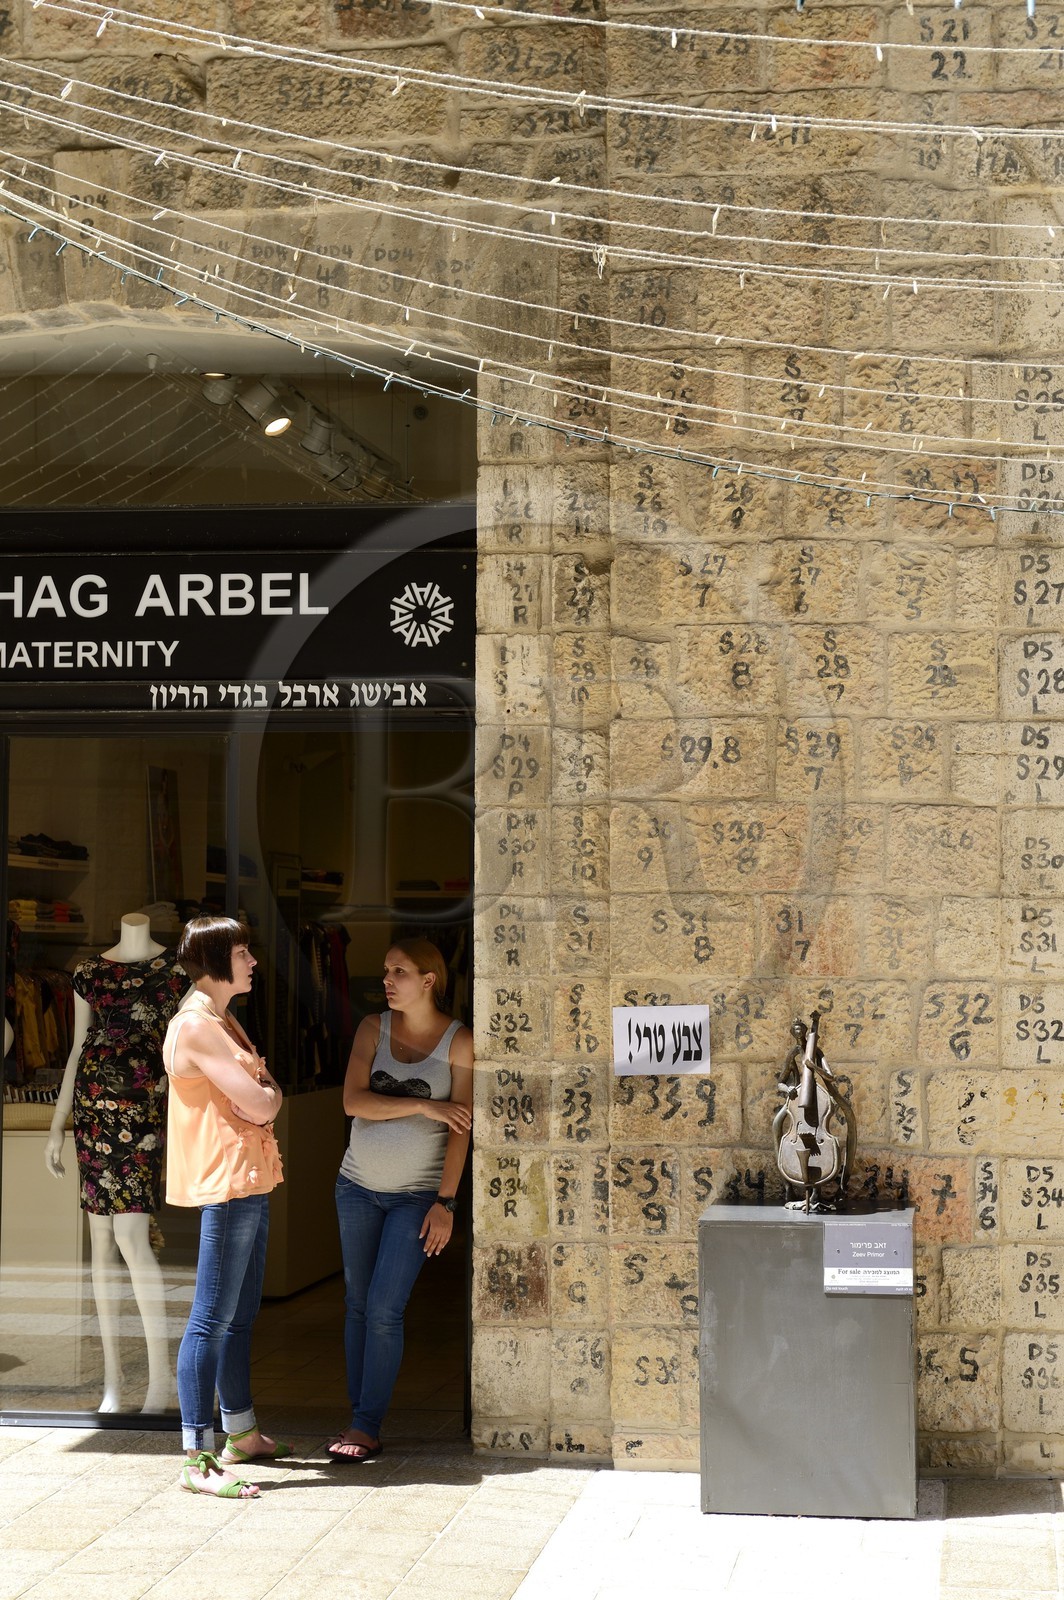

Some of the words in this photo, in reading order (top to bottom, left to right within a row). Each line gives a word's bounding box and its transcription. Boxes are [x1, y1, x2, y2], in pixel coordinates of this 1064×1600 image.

[1033, 421, 1047, 441] L
[1020, 554, 1051, 575] D5
[135, 572, 329, 617] ARBEL
[1027, 607, 1042, 628] L
[823, 629, 838, 653] S
[1023, 640, 1054, 662] D5
[0, 640, 180, 668] ATERNITY
[570, 661, 597, 683] 28
[731, 660, 753, 691] 8
[814, 654, 850, 679] 28
[150, 684, 208, 710] הריון
[218, 684, 268, 708] בגדי
[279, 681, 339, 707] ארבל
[350, 682, 427, 707] אבישג
[1032, 695, 1047, 715] L
[1020, 725, 1051, 750] D5
[493, 755, 540, 780] S29
[804, 765, 824, 791] 7
[1035, 782, 1049, 803] L
[1024, 836, 1051, 851] D5
[637, 846, 654, 873] 9
[572, 905, 590, 926] S
[1020, 906, 1053, 928] D5
[493, 925, 527, 944] S31
[1019, 930, 1058, 953] S31
[507, 949, 521, 967] R
[794, 940, 811, 963] 7
[1031, 956, 1046, 975] L
[490, 1012, 533, 1033] S32
[1015, 1019, 1064, 1043] S32
[628, 1018, 666, 1064] טרי!
[672, 1021, 702, 1065] צבע
[949, 1030, 972, 1061] 6
[1036, 1045, 1051, 1064] L
[496, 1068, 525, 1090] D4
[1026, 1165, 1054, 1183] D5
[1020, 1185, 1064, 1209] S34
[504, 1200, 518, 1218] R
[979, 1206, 997, 1231] 6
[1036, 1212, 1049, 1231] L
[1026, 1251, 1052, 1269] D5
[1018, 1272, 1061, 1295] S35
[1034, 1300, 1047, 1319] L
[1028, 1342, 1059, 1364] D5
[1038, 1394, 1053, 1416] L
